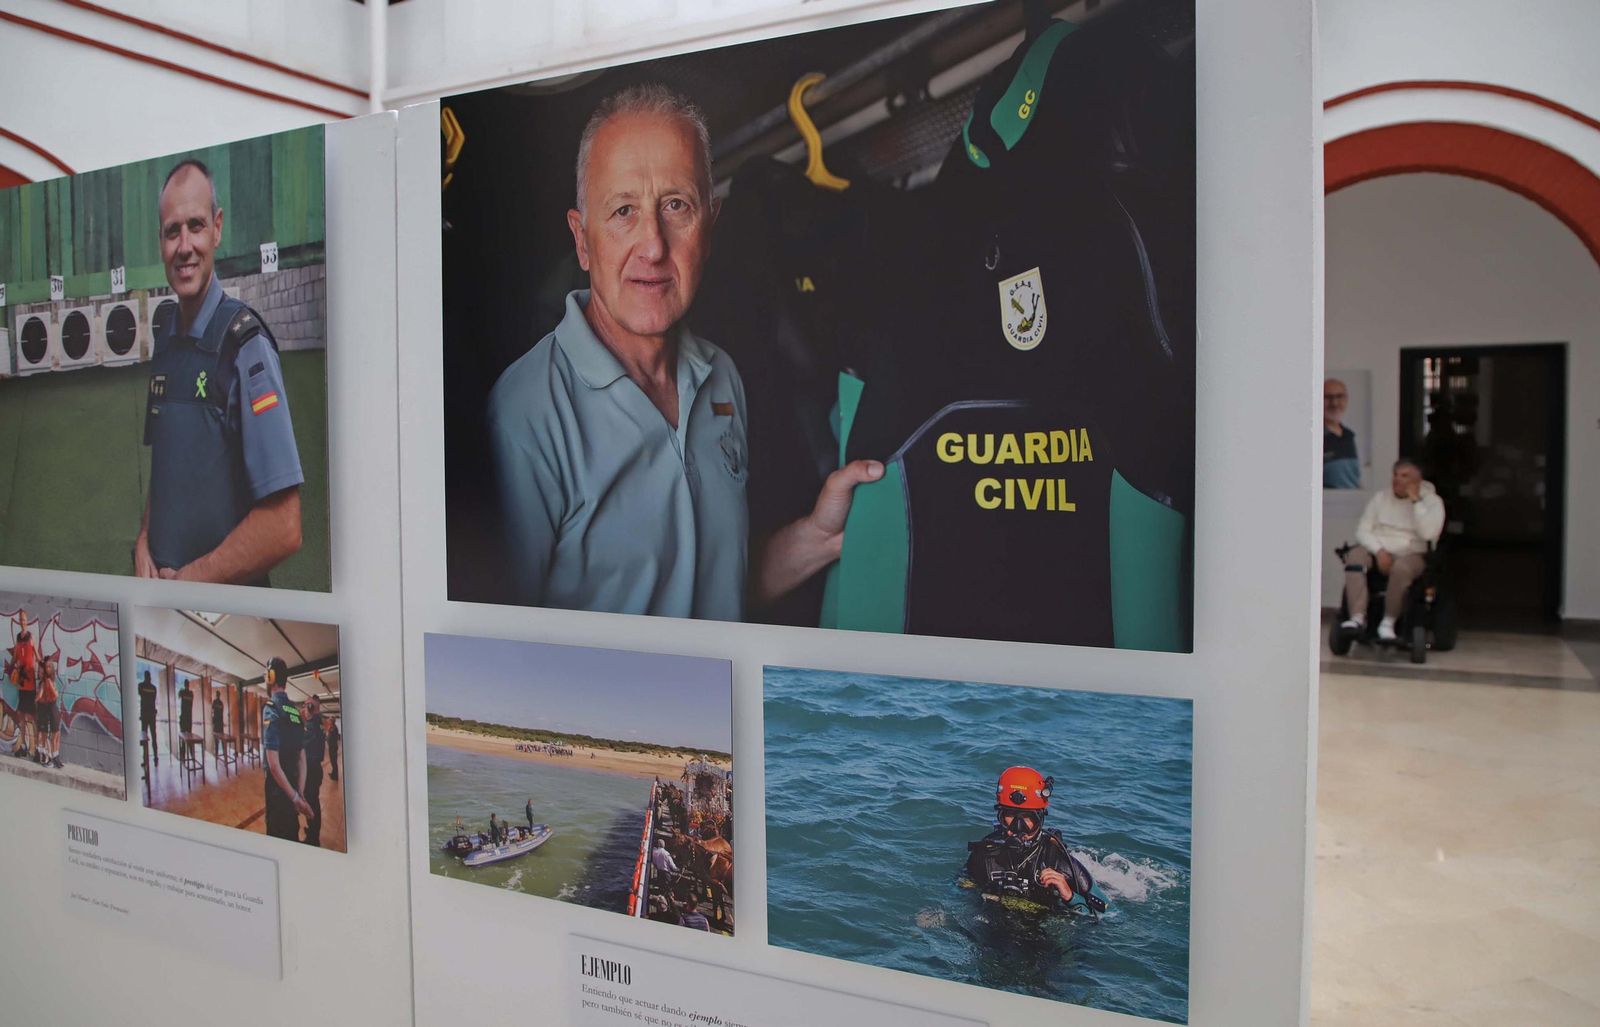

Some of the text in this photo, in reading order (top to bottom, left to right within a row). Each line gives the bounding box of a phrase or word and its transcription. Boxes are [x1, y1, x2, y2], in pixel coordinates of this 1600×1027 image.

[1018, 89, 1036, 120] GC
[51, 278, 63, 293] 30
[112, 268, 124, 286] 31
[1007, 313, 1044, 344] GUARDIA CIVIL
[935, 427, 1094, 465] GUARDIA
[974, 477, 1076, 513] CIVIL
[67, 823, 99, 847] PRESTIGIO
[581, 954, 632, 986] EJEMPLO
[582, 983, 618, 1001] Entiendo
[618, 995, 633, 1005] que
[634, 1000, 660, 1012] actuar
[661, 1003, 687, 1018] dando
[688, 1010, 723, 1026] ejemplo
[582, 999, 600, 1010] pero
[601, 1003, 633, 1018] también
[634, 1011, 643, 1021] sé
[644, 1015, 659, 1026] que
[661, 1019, 673, 1027] no
